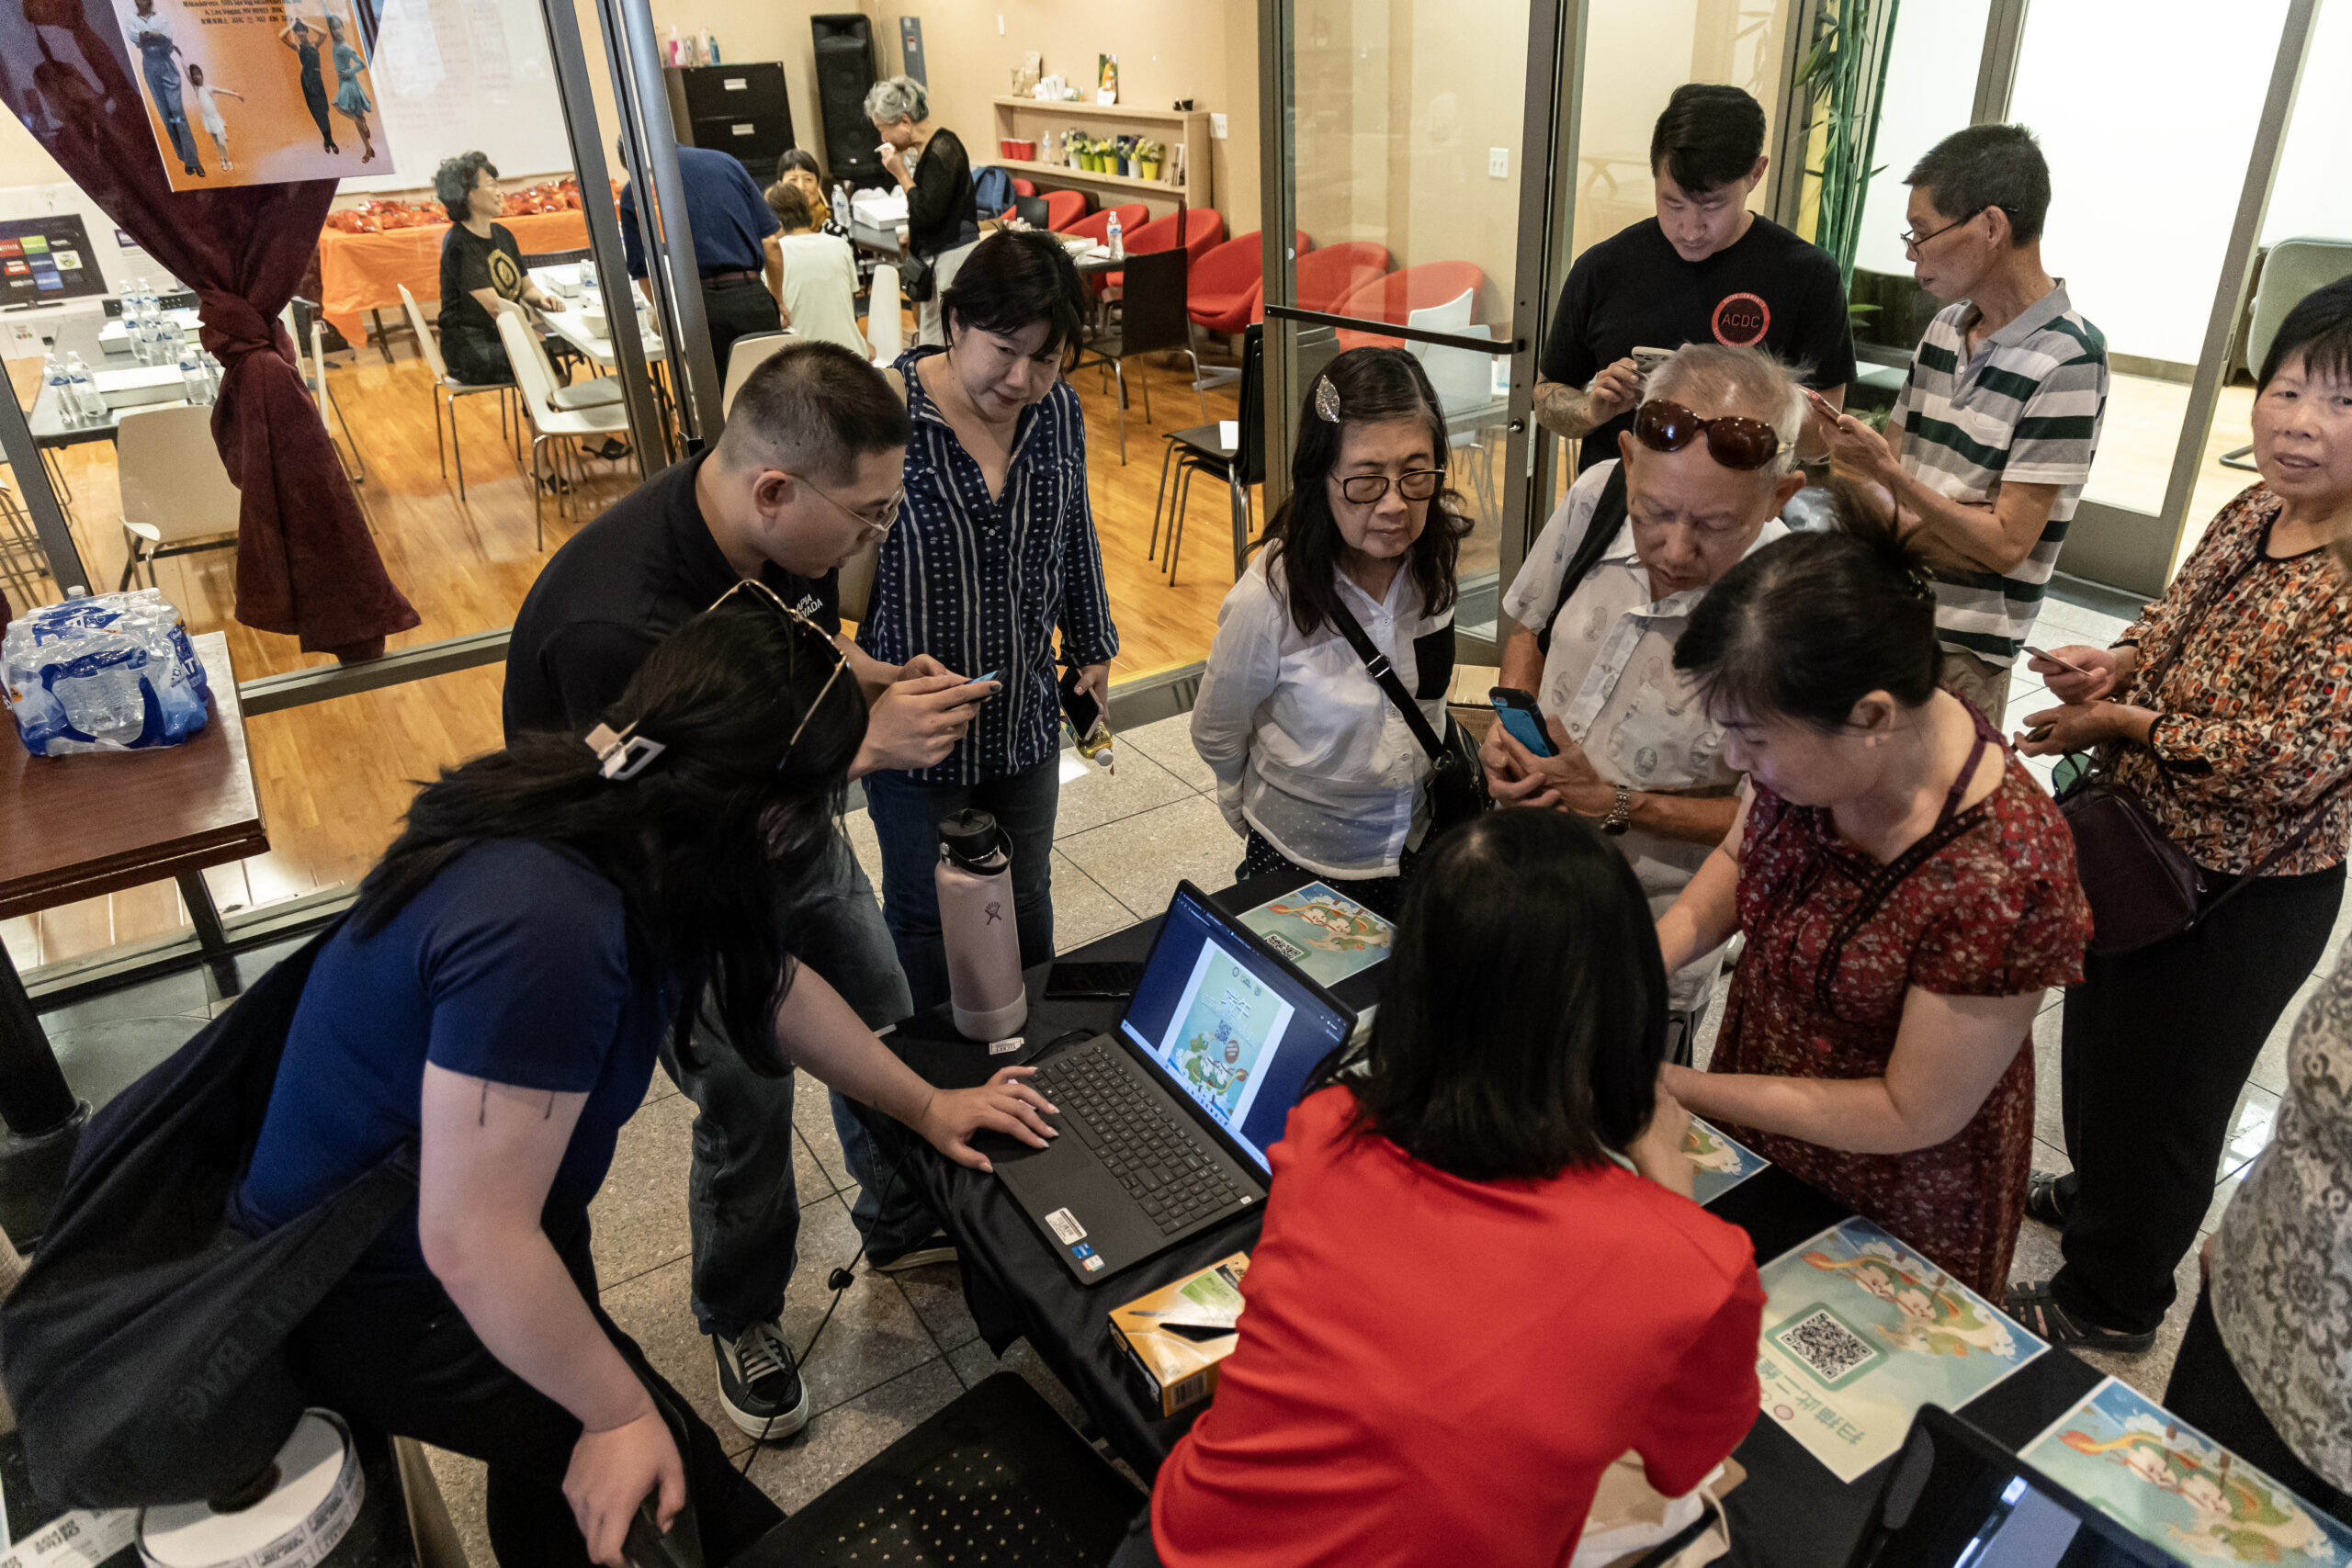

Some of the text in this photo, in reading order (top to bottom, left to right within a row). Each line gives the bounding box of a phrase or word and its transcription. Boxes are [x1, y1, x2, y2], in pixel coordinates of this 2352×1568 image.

[1721, 312, 1760, 329] ACDC
[793, 598, 823, 623] NVADA
[797, 593, 813, 612] APIA
[1757, 1357, 1865, 1445] 扫描此二维
